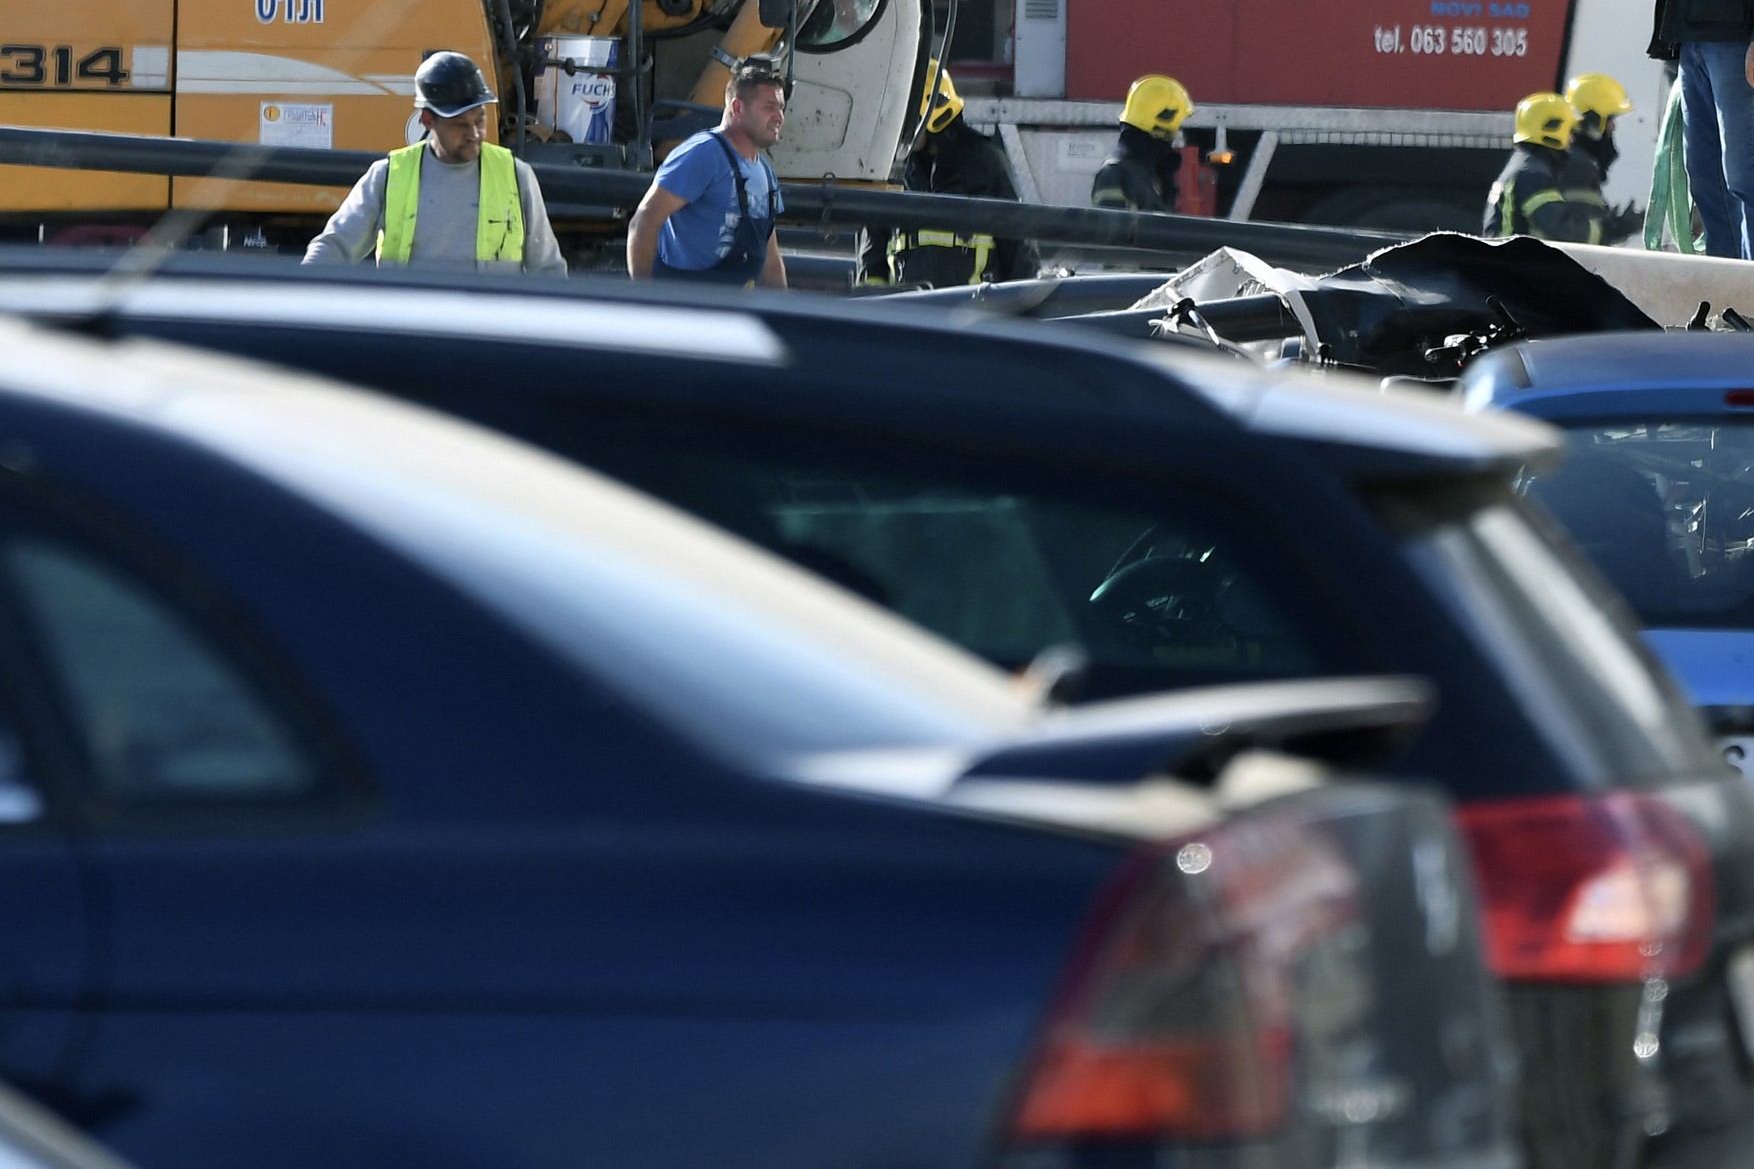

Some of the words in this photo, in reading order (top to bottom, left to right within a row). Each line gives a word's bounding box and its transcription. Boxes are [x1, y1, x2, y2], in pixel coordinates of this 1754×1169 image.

[1431, 0, 1483, 17] NOVI
[1488, 2, 1530, 18] SAD
[1374, 24, 1405, 53] tel.
[1411, 26, 1446, 54] 063
[1451, 27, 1487, 56] 560
[1491, 29, 1528, 57] 305
[0, 45, 130, 87] 314
